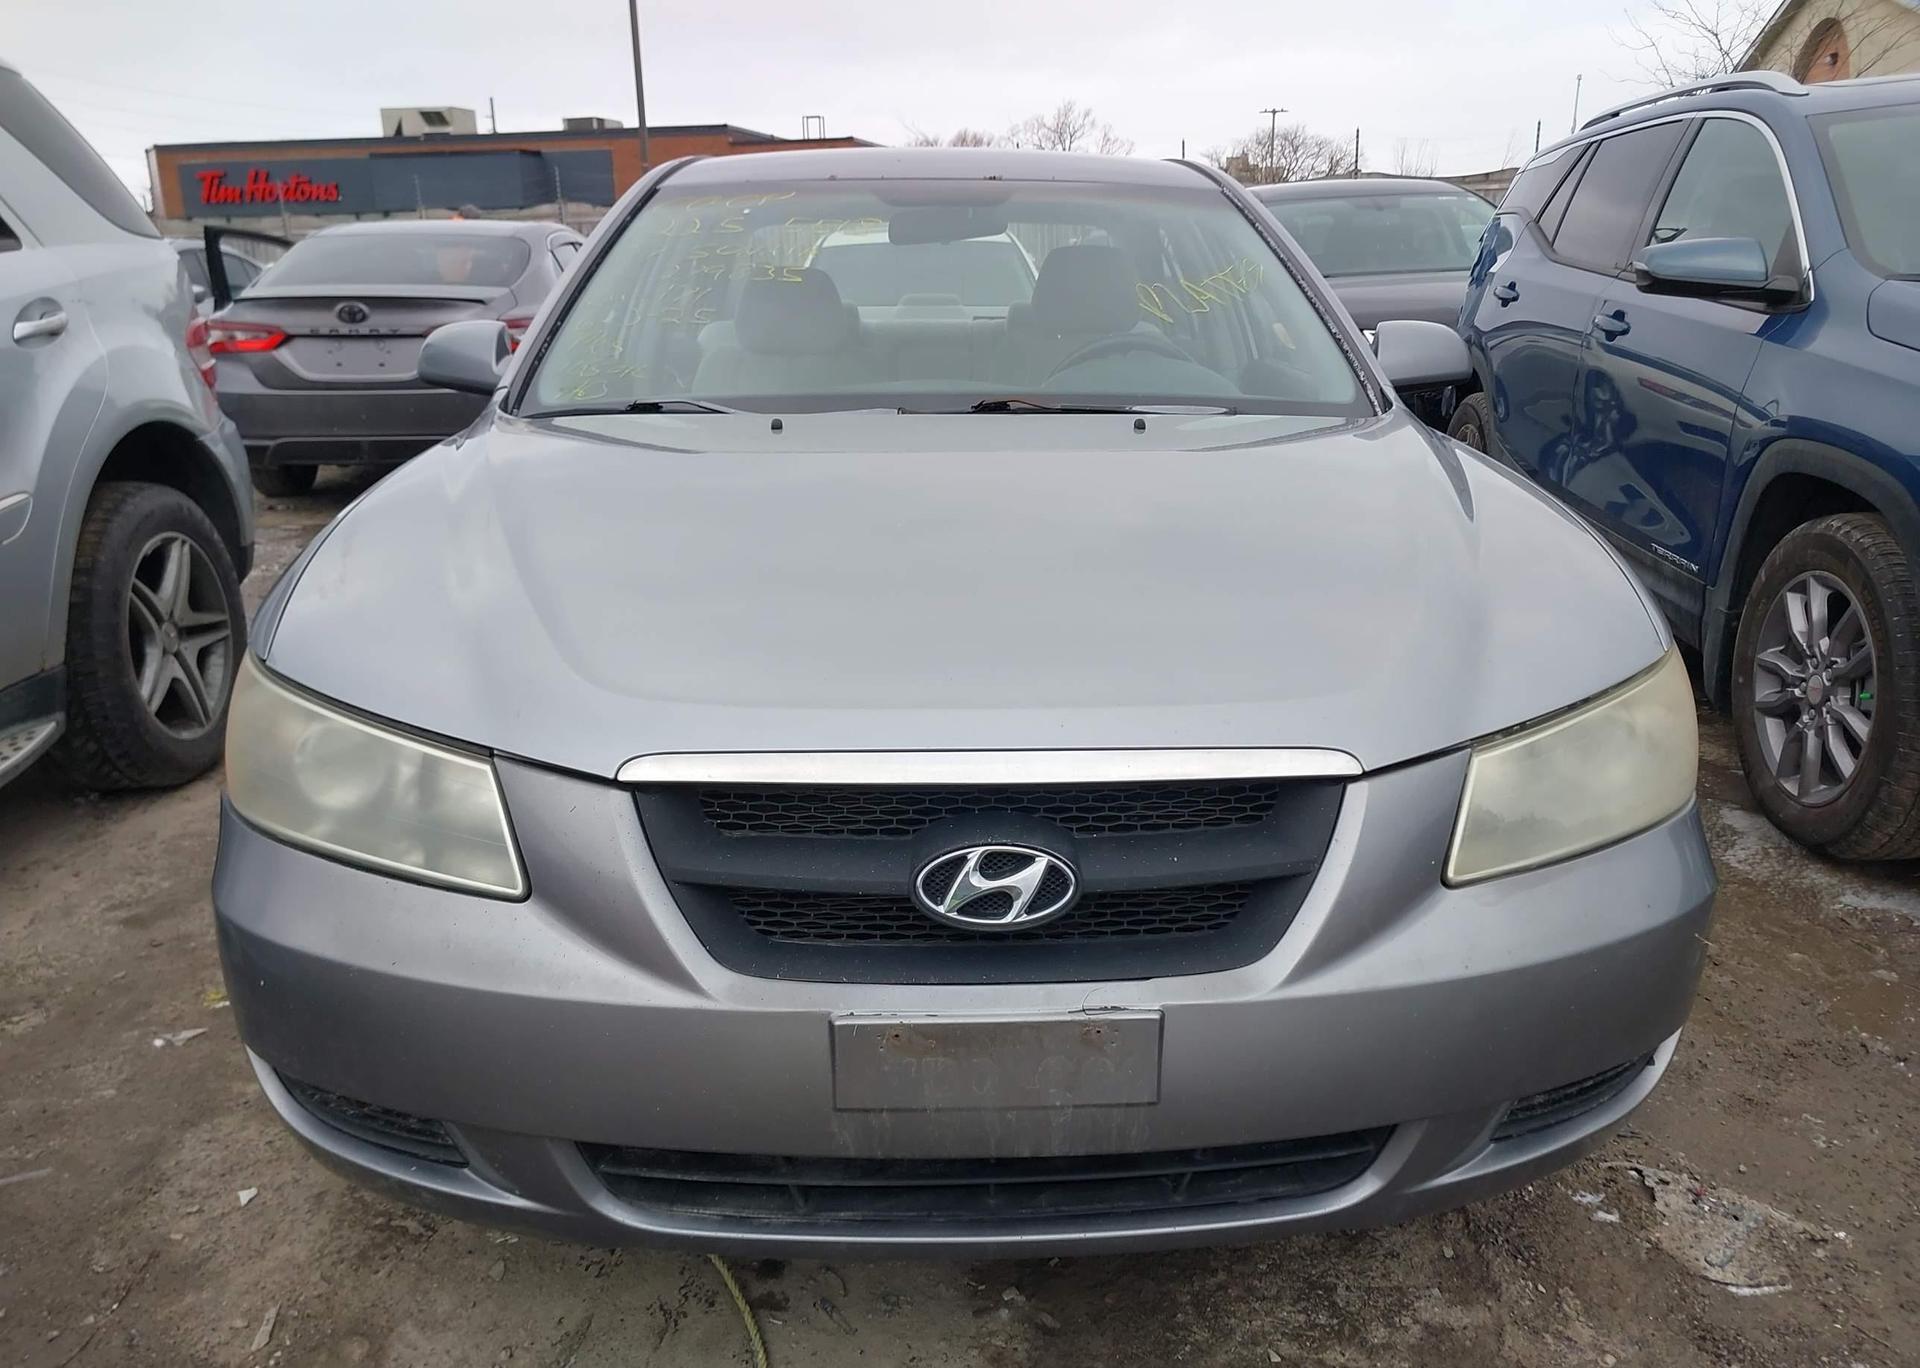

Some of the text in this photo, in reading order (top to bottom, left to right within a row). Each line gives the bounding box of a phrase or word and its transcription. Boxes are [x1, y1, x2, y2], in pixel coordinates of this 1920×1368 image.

[195, 168, 338, 204] Tim Hortons
[1650, 542, 1699, 573] TERRAIN
